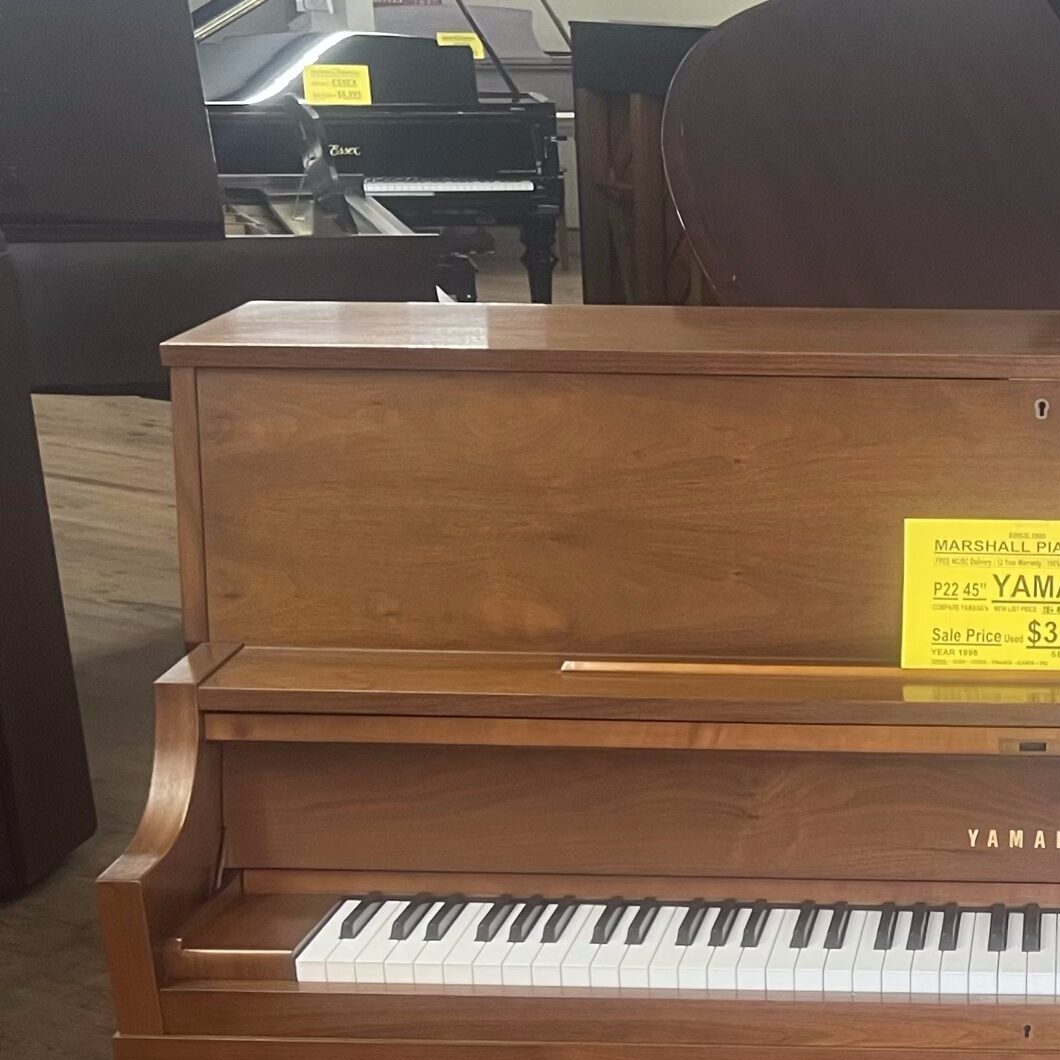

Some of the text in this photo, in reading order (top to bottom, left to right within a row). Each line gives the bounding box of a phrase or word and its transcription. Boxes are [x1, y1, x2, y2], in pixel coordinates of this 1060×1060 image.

[328, 144, 362, 157] Essex
[934, 539, 1031, 553] MARSHALL
[935, 557, 950, 566] FREE
[934, 582, 959, 597] P22
[963, 582, 987, 597] 45"
[932, 627, 962, 642] Sale
[966, 628, 1002, 643] Price
[1004, 634, 1024, 643] Used
[931, 649, 956, 657] YEAR
